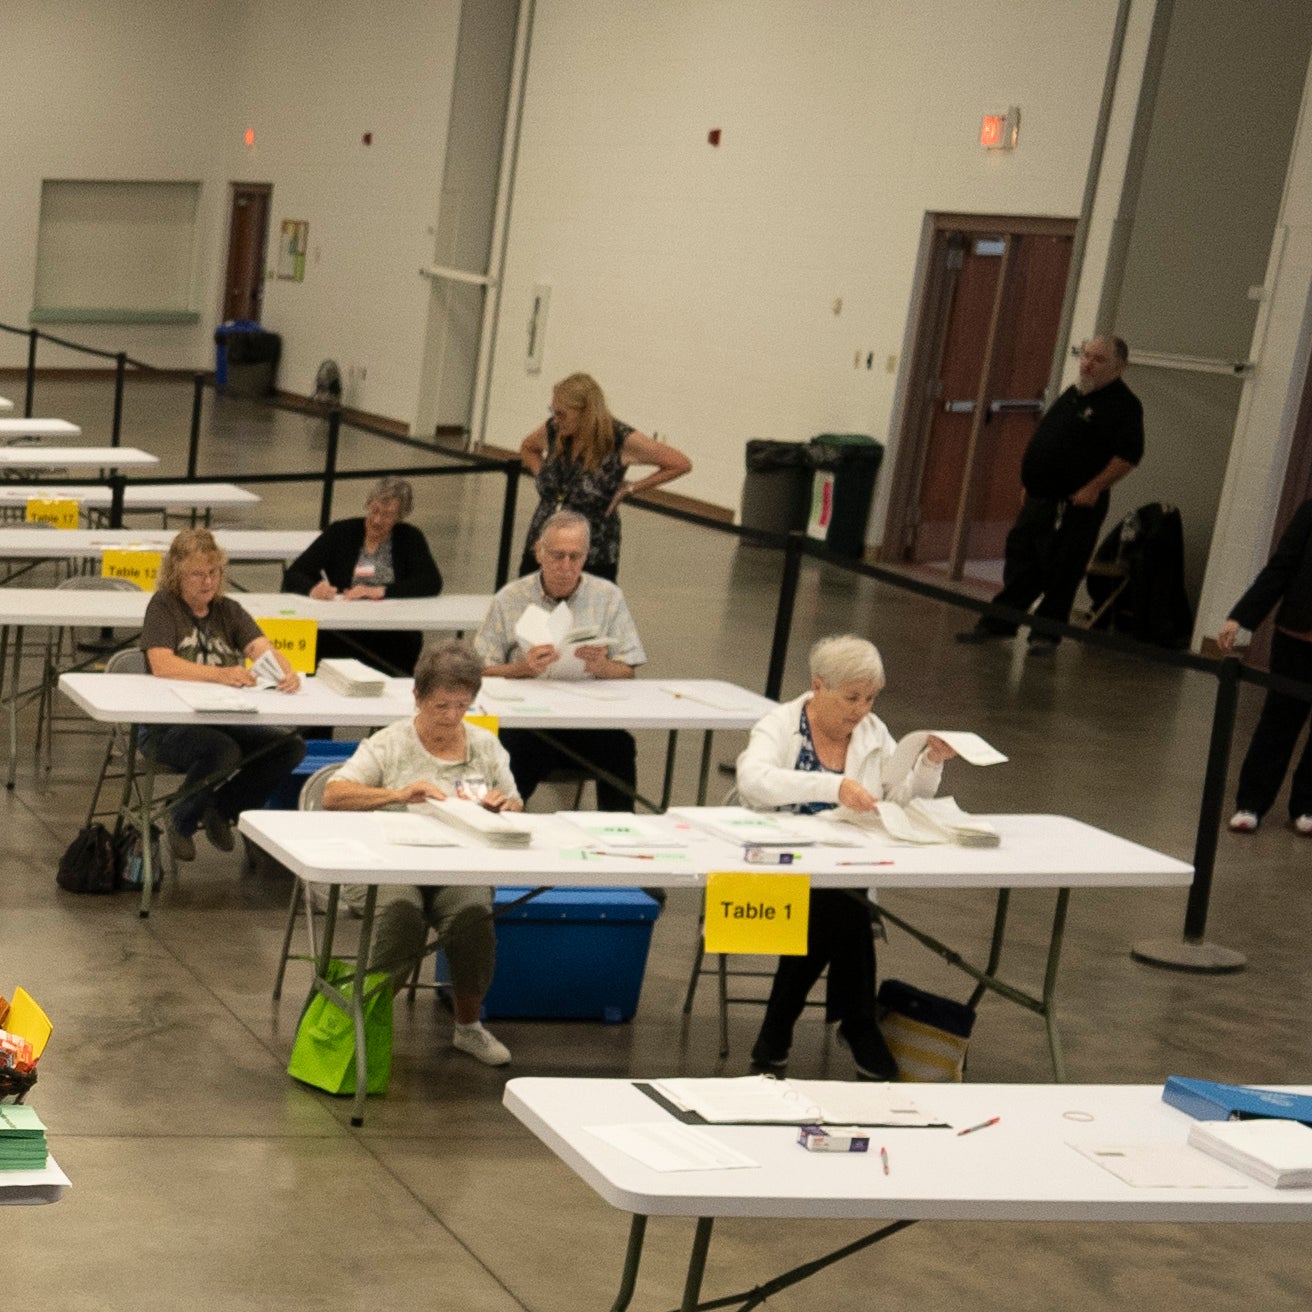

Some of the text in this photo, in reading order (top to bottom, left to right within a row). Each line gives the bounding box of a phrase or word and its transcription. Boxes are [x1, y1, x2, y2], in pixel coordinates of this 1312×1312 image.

[109, 565, 140, 577] Table
[298, 639, 306, 652] 9
[721, 901, 792, 920] Table 1
